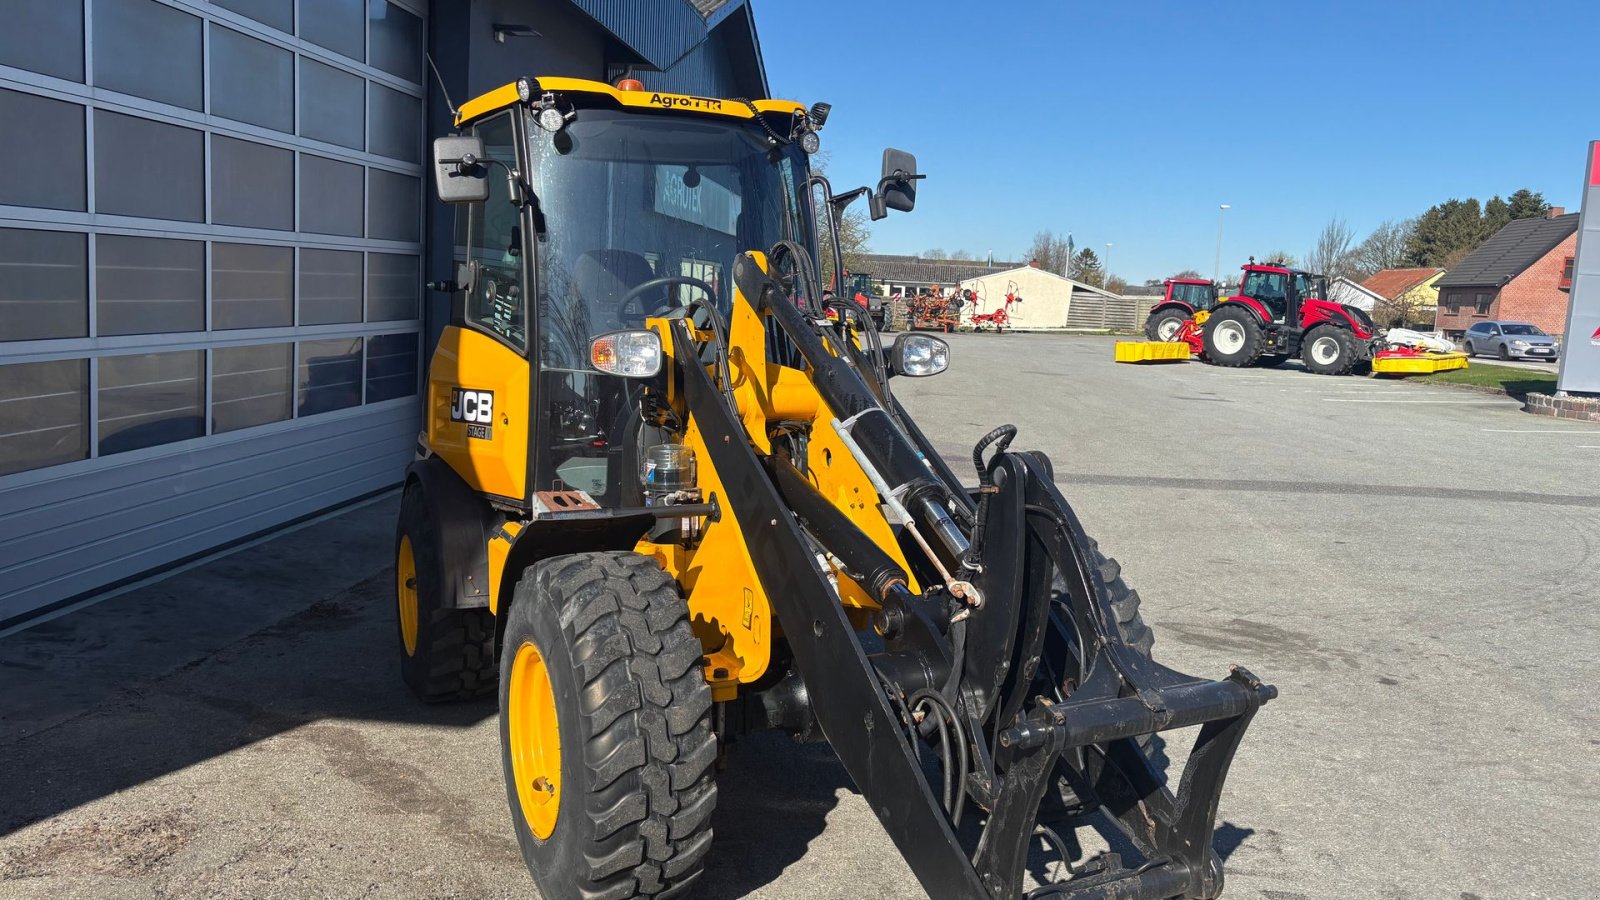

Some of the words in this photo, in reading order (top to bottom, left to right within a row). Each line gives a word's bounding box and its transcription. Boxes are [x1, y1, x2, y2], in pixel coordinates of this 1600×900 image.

[650, 94, 722, 110] AgroTEK
[452, 391, 493, 423] JCB
[468, 426, 486, 438] STAGE
